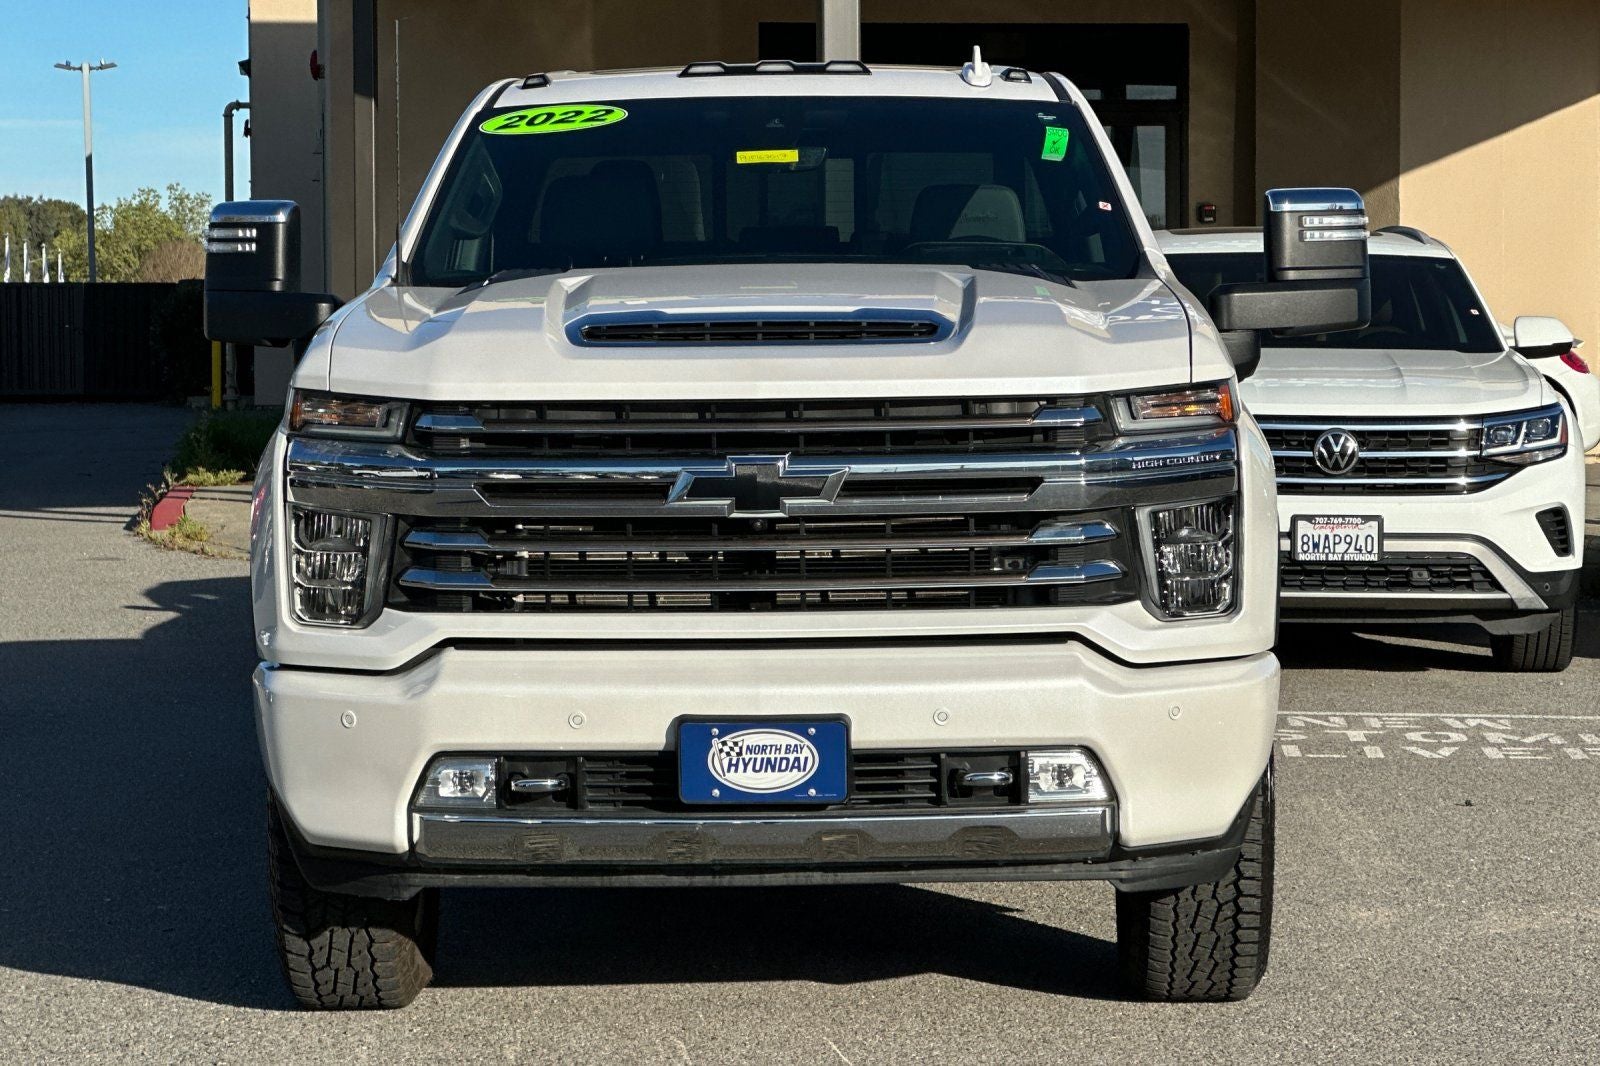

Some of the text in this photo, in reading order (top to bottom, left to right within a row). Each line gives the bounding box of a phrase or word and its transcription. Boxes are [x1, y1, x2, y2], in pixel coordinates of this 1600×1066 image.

[494, 109, 615, 130] 2022
[1132, 453, 1222, 469] HIGH COUNTRY
[1301, 534, 1374, 554] 8WAP940
[1300, 553, 1378, 561] NORTH BAY HYUNDAI
[745, 744, 806, 756] NORTH BAY
[726, 757, 808, 773] HYUNDAI
